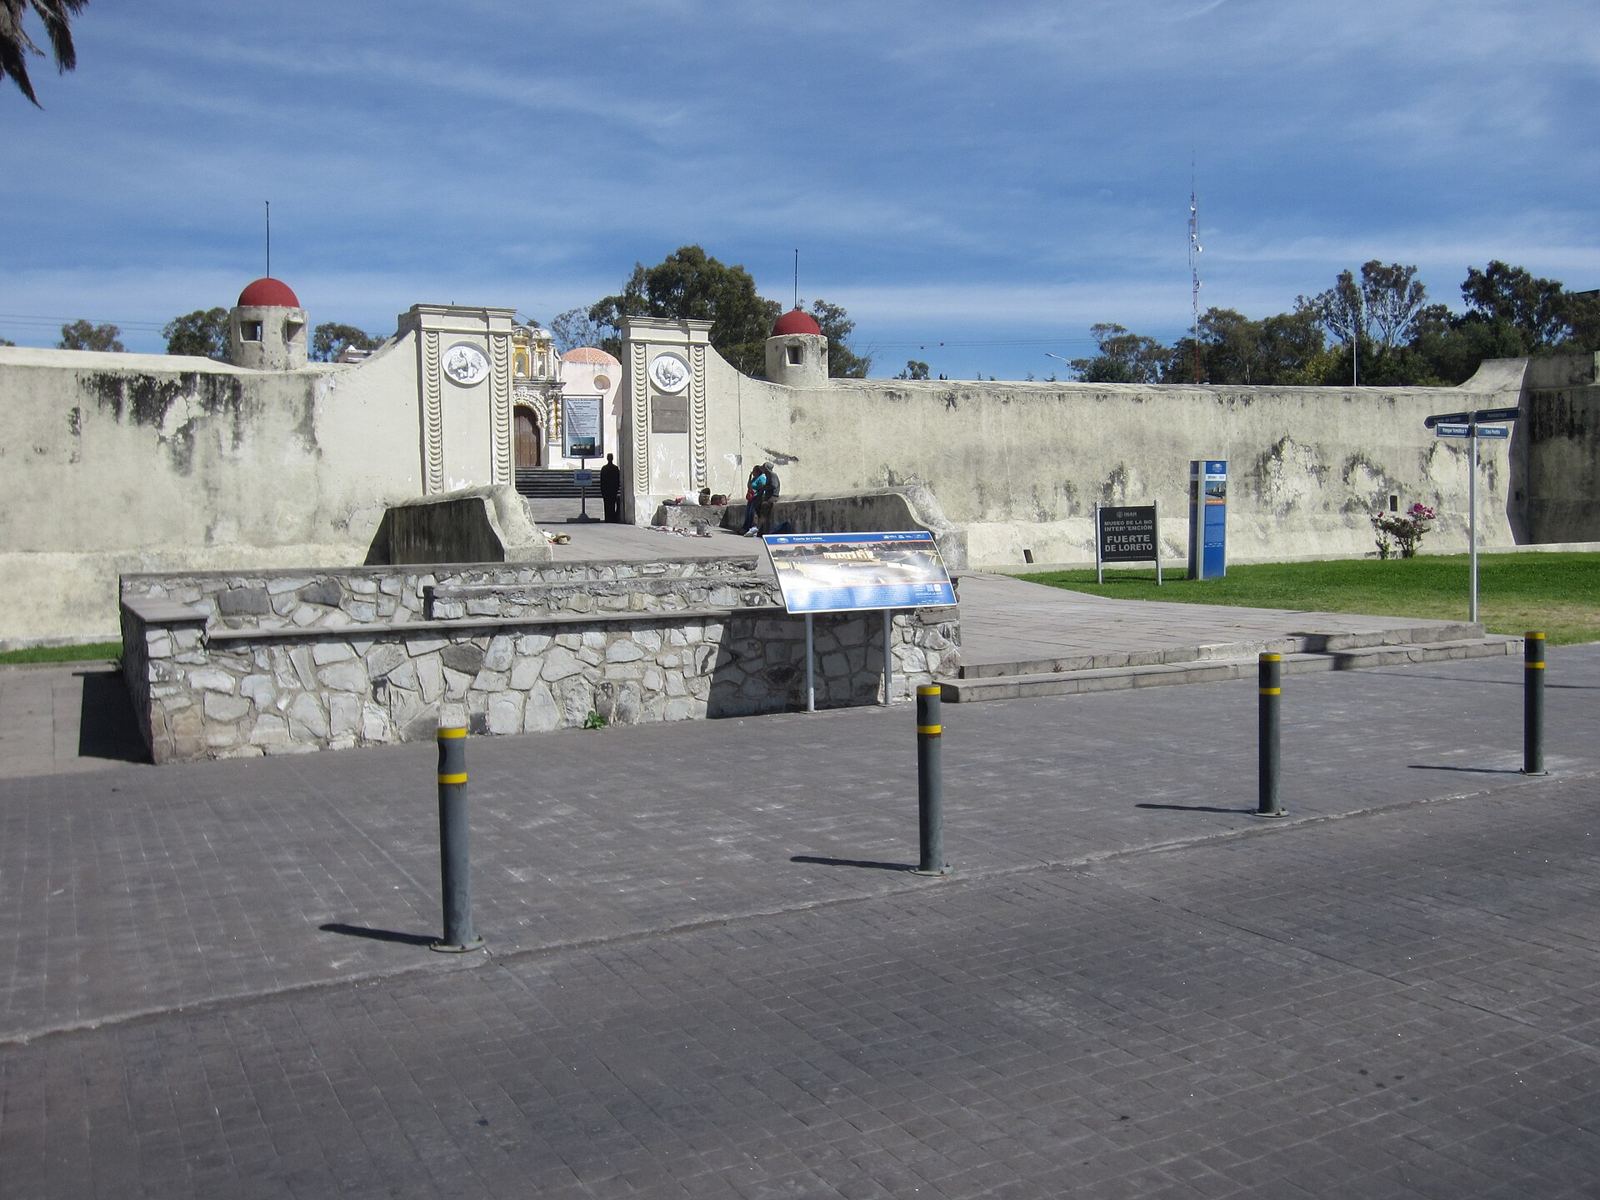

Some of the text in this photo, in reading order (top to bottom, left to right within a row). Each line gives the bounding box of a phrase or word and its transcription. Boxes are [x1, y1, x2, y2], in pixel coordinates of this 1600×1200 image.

[1107, 534, 1150, 543] FUERTE
[1105, 543, 1153, 552] DE LORETO
